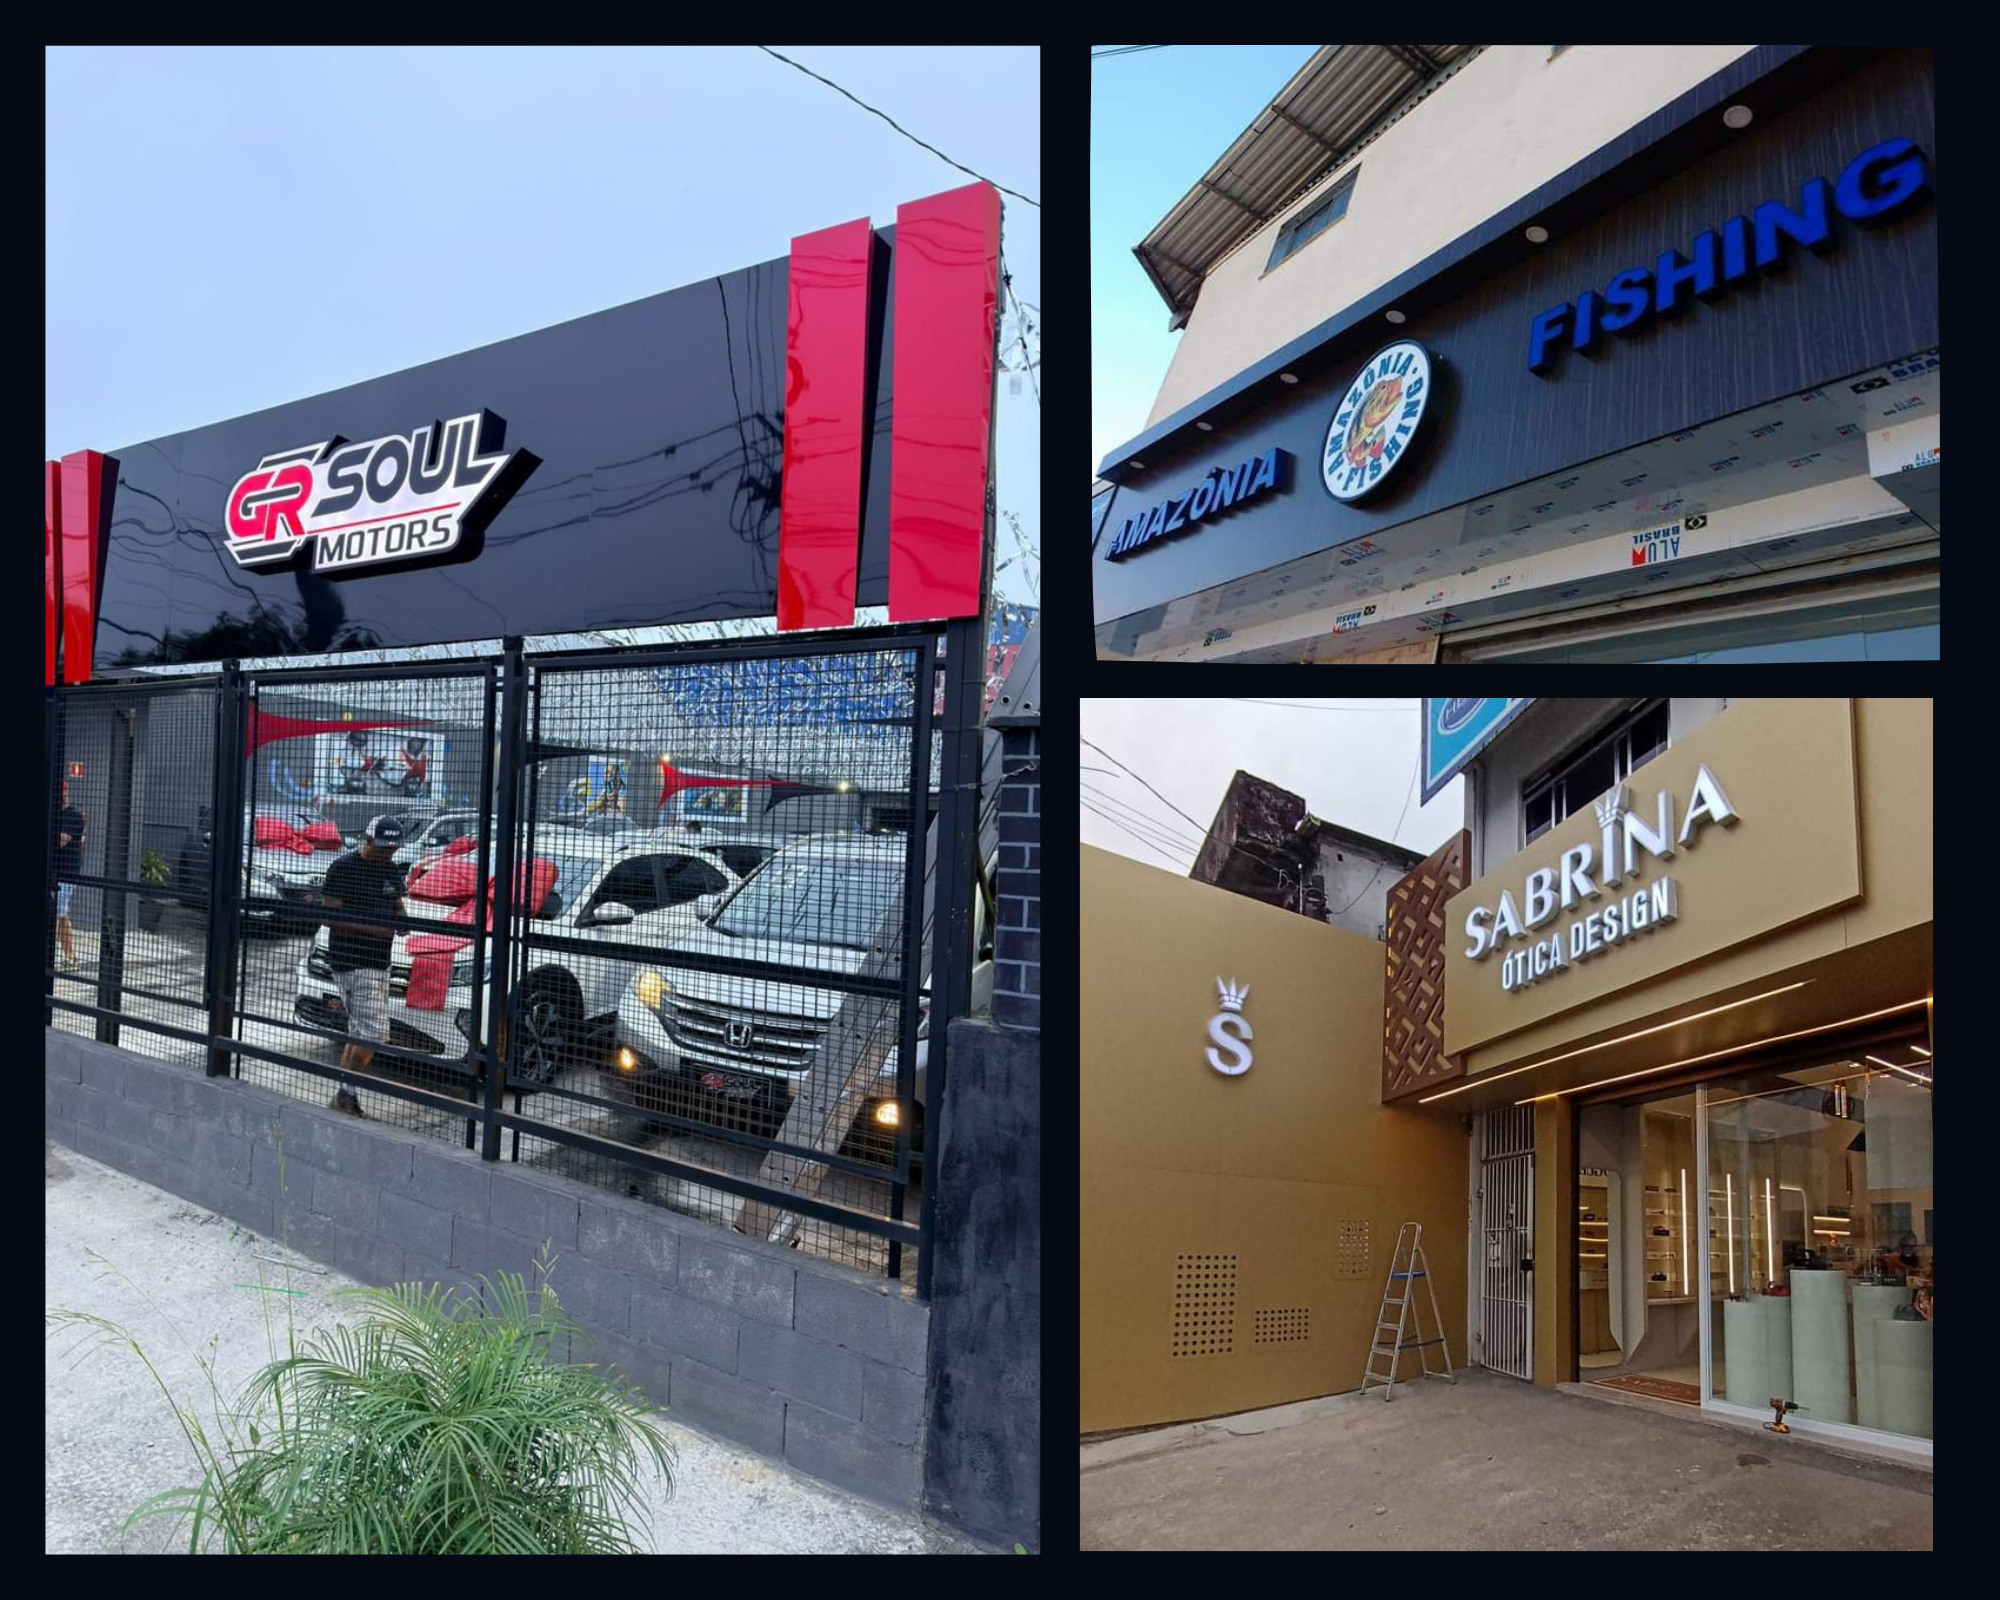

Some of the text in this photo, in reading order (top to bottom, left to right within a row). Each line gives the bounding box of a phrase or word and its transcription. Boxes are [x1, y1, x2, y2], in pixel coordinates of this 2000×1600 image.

[1528, 137, 1928, 374] FISHING
[1328, 352, 1415, 475] AMAZÔNIA
[1342, 377, 1424, 491] FISHING
[228, 419, 497, 541] GR SOUL
[1104, 447, 1286, 560] AMAZÔNIA
[1632, 525, 1680, 544] BRASIL
[318, 514, 453, 564] MOTORS
[1464, 764, 1739, 960] SABRINA
[1502, 876, 1676, 991] ÓTICA DESIGN
[1204, 1012, 1253, 1076] S
